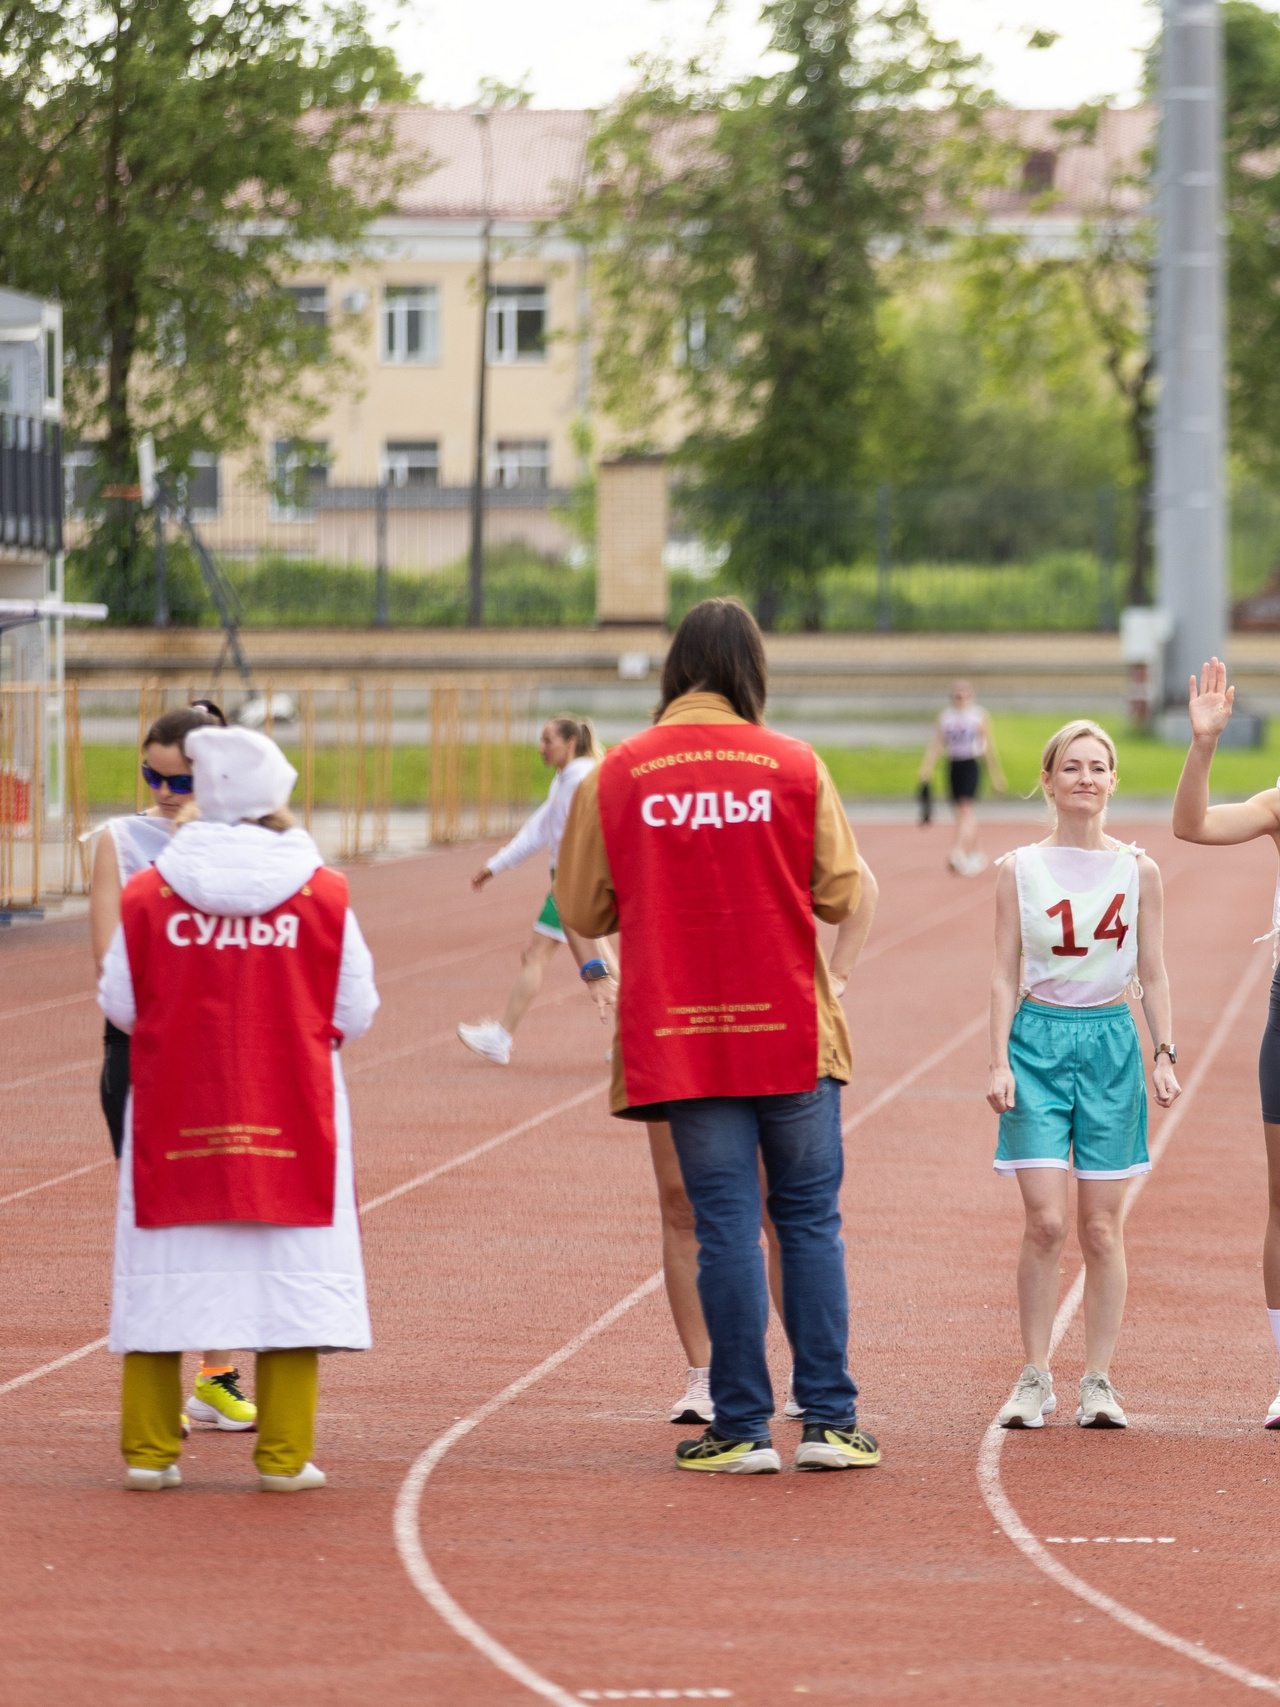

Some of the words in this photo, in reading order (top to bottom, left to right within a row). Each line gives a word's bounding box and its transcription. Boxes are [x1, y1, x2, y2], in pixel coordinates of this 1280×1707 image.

[630, 750, 713, 778] ПСКОВСКАЯ
[716, 750, 779, 769] ОБЛАСТЬ
[641, 789, 771, 830] СУДЬЯ
[166, 912, 300, 950] СУДЬЯ
[1045, 893, 1129, 957] 14
